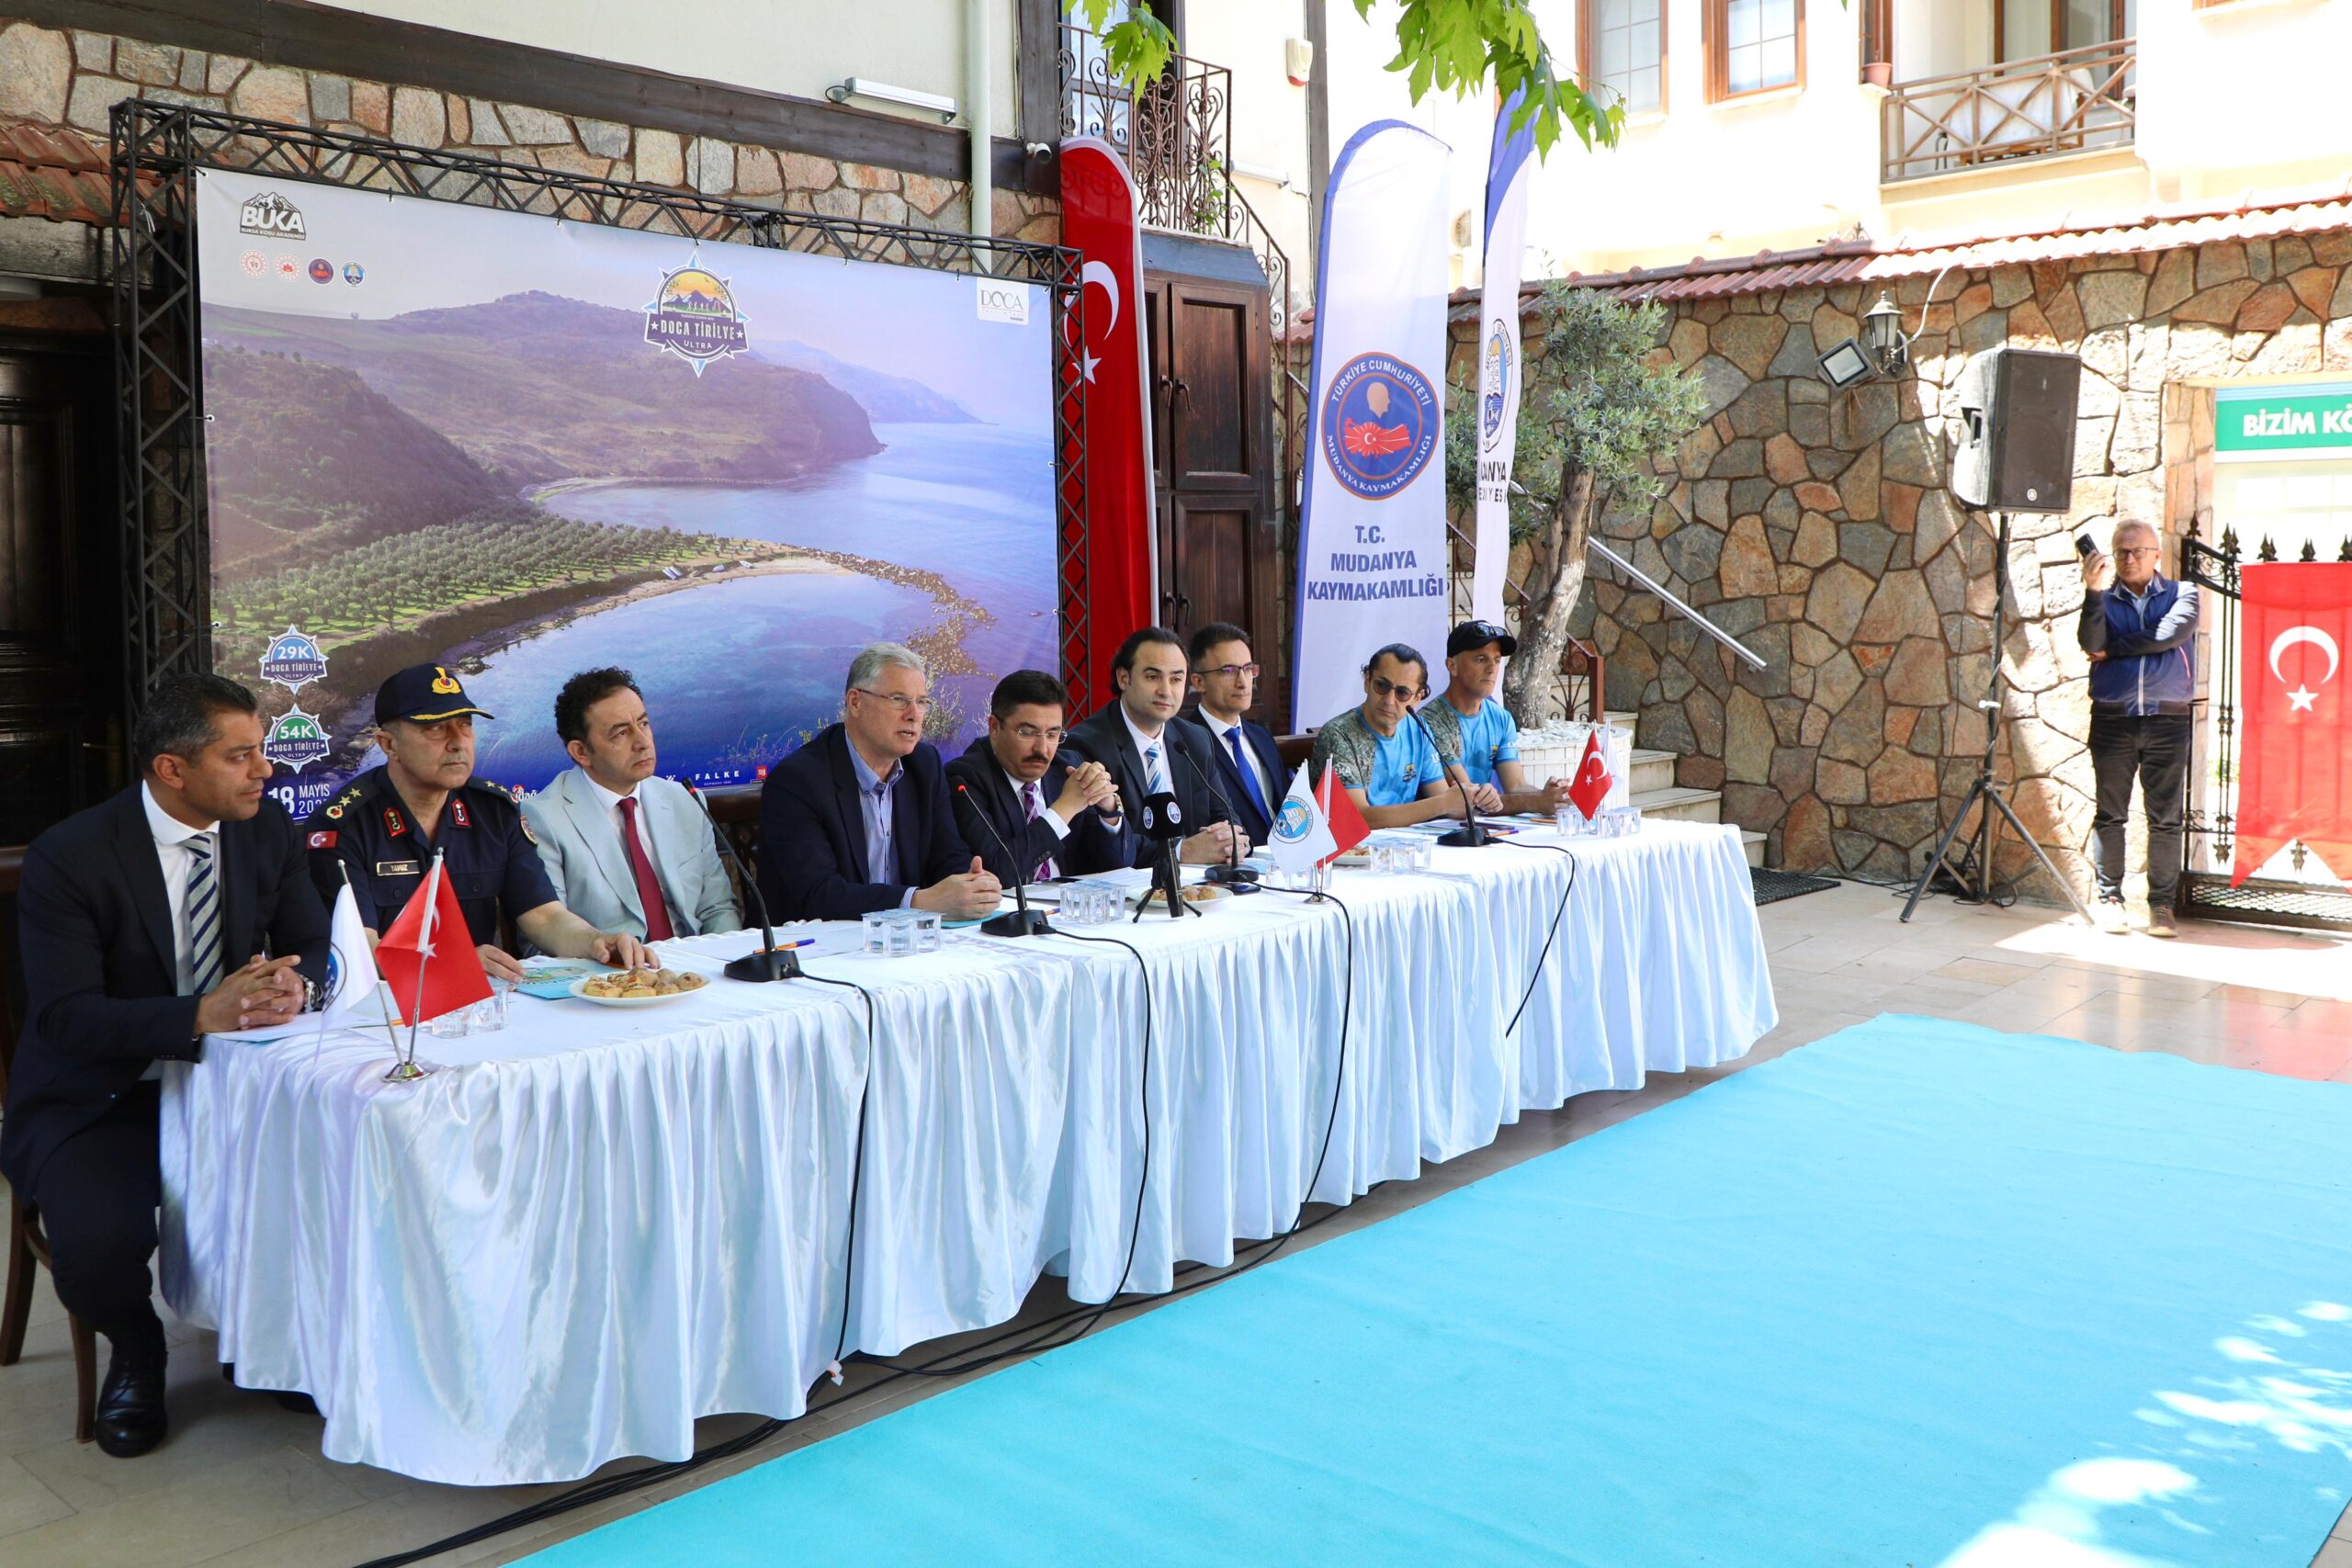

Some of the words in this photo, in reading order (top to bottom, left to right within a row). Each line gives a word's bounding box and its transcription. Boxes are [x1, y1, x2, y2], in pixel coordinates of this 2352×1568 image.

[241, 206, 305, 233] BUKA
[980, 289, 1023, 310] DOCA
[661, 320, 690, 335] DOCA
[695, 321, 735, 340] TİRİLYE
[684, 340, 712, 349] ULTRA
[1331, 362, 1367, 402] TÜRKİYE
[1368, 359, 1432, 406] CUMHURİYETİ
[2243, 407, 2316, 436] BİZİM
[1327, 434, 1358, 487] MUDANYA
[1354, 525, 1385, 544] T.C.
[1330, 550, 1418, 572] MUDANYA
[1307, 573, 1443, 601] KAYMAKAMLIĞI
[277, 646, 311, 660] 29K
[291, 662, 317, 671] TİRİLYE
[279, 725, 314, 739] 54K
[274, 744, 292, 752] DOCA
[294, 741, 320, 750] TİRİLYE
[695, 771, 740, 781] FALKE
[299, 784, 330, 798] MAYIS
[299, 798, 327, 814] 20
